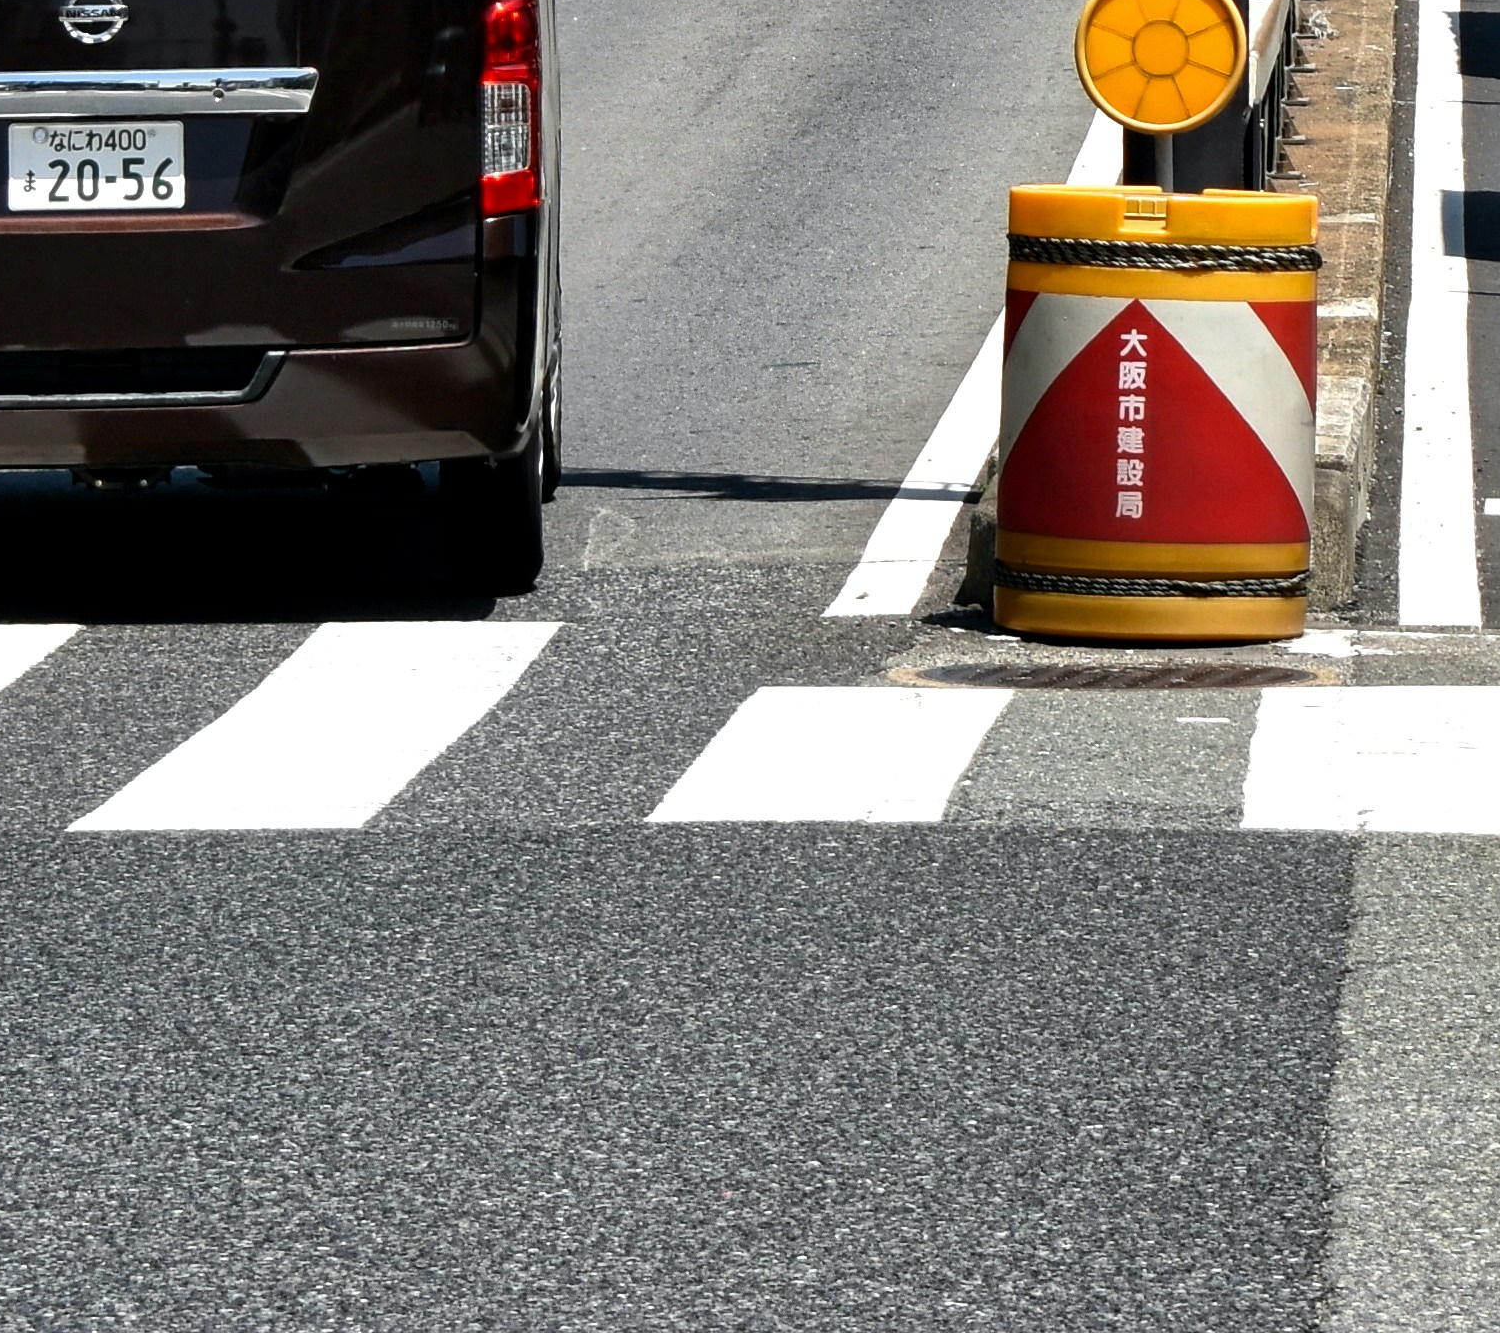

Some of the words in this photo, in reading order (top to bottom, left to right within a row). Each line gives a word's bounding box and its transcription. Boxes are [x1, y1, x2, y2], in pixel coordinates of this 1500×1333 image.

[65, 8, 121, 18] NISSAN
[49, 129, 147, 152] なにわ400
[23, 169, 37, 192] ま
[48, 157, 174, 202] 20-56
[1115, 328, 1148, 520] 大阪市建設局
